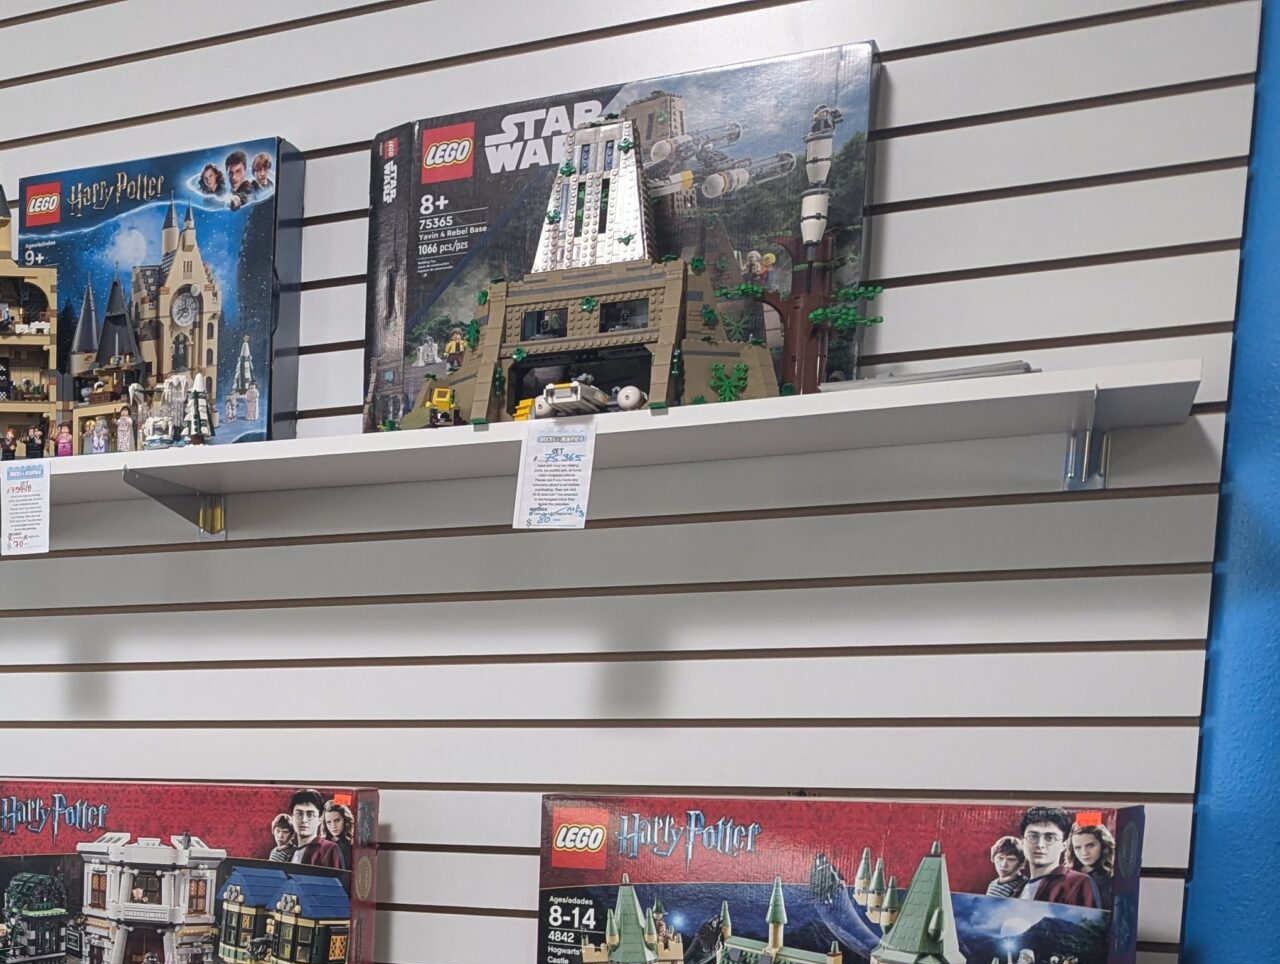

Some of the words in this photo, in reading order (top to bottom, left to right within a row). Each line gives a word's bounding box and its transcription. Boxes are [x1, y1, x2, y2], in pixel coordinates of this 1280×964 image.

[424, 139, 473, 169] LEGO
[383, 162, 391, 203] WARS
[389, 160, 398, 202] STAR
[28, 194, 60, 214] LEGO
[67, 181, 114, 217] Harry
[116, 172, 165, 206] Potter
[421, 194, 449, 215] 8+
[419, 216, 453, 230] 75365
[419, 232, 439, 241] Yavin
[440, 231, 446, 239] 4
[447, 228, 468, 238] Rebel
[469, 225, 487, 234] Base
[25, 250, 45, 266] 9+
[418, 243, 438, 255] 1066
[439, 240, 468, 254] pcs/pzs
[52, 793, 109, 847] Potter
[554, 824, 607, 852] LEGO
[615, 813, 684, 859] Harry
[686, 810, 762, 874] Potter
[548, 895, 593, 906] Ages/edades
[549, 905, 596, 930] 8-14
[548, 930, 575, 943] 4842
[547, 956, 569, 964] Castle
